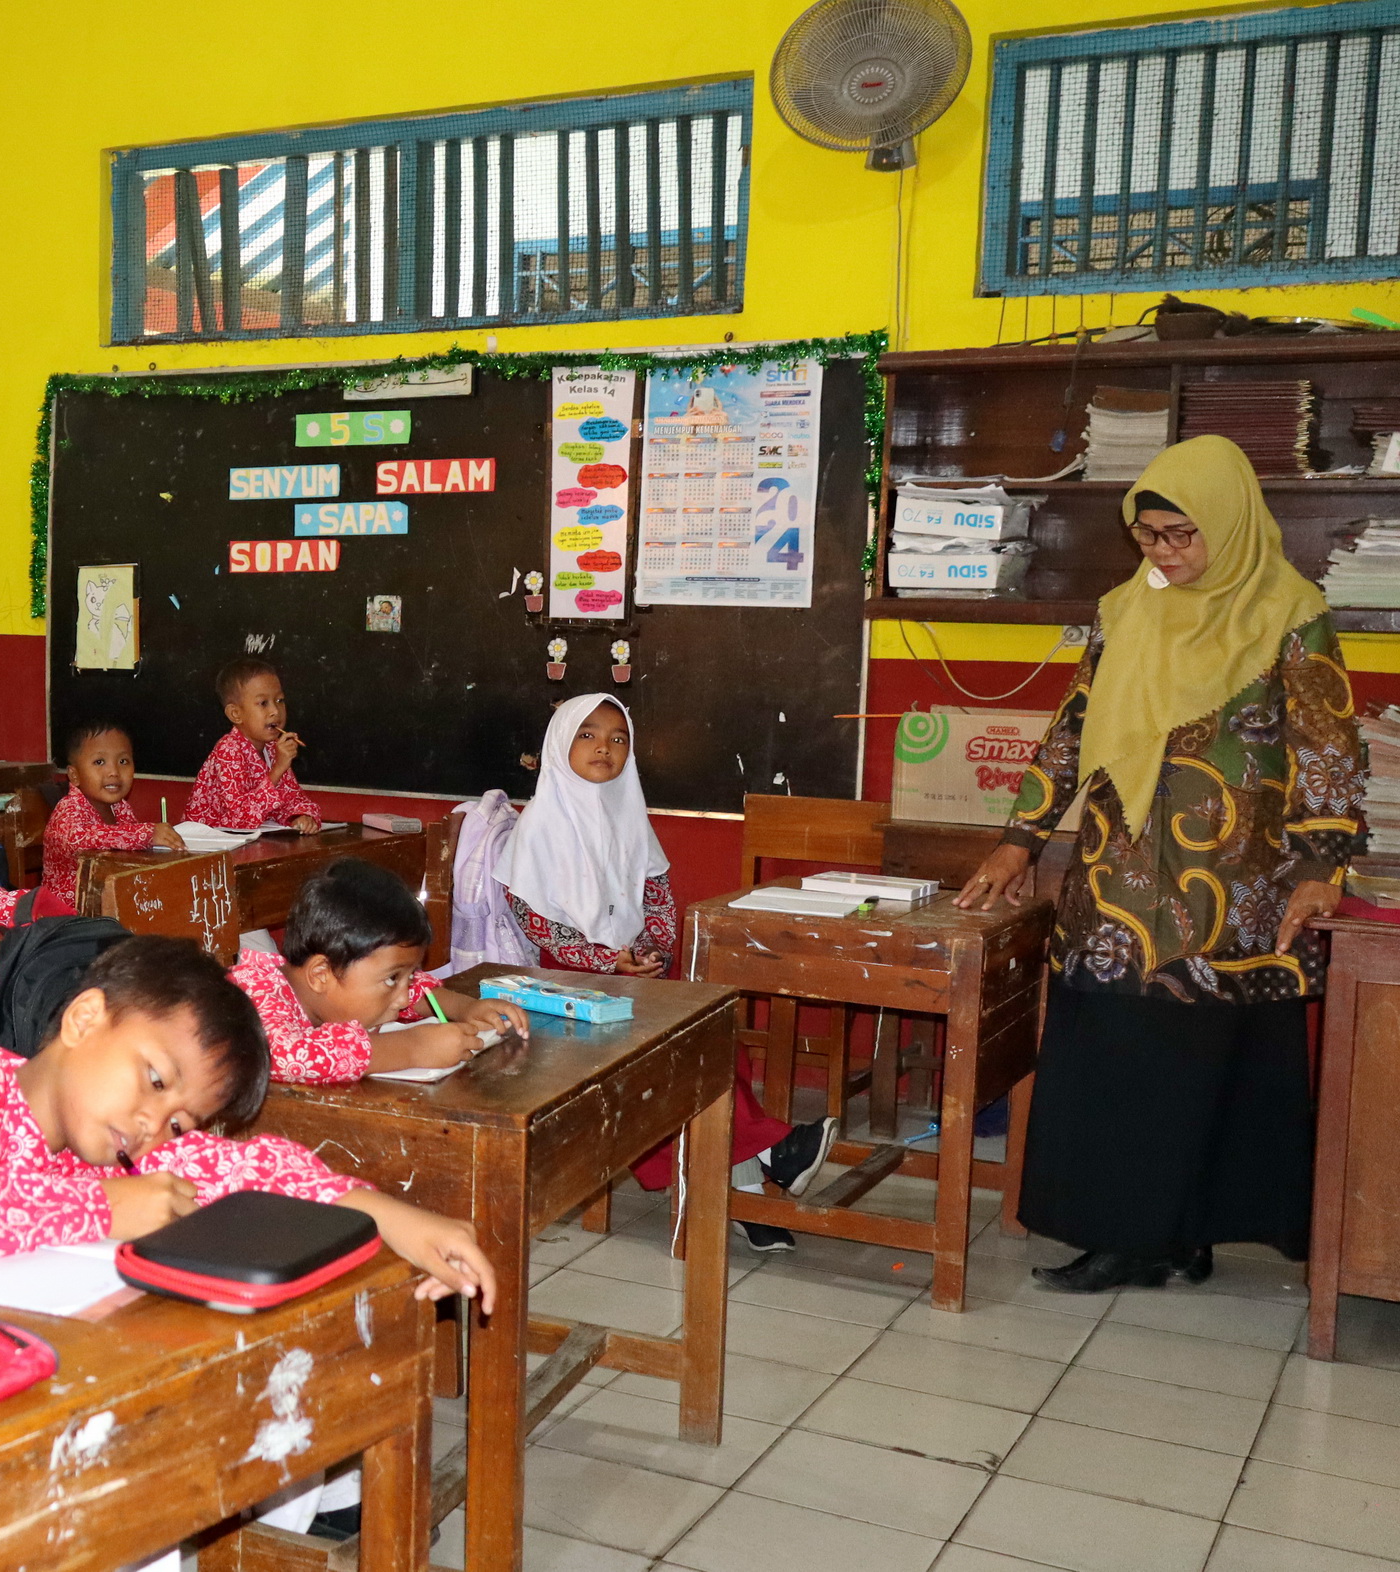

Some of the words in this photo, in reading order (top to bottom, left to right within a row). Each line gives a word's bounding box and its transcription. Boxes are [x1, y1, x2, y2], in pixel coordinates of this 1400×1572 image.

[569, 386, 599, 394] Kelas
[603, 386, 616, 397] 1A
[329, 412, 350, 446] 5
[362, 413, 385, 443] S
[654, 425, 694, 435] MENJEMPUT
[696, 424, 742, 434] KEMENANGAN
[230, 466, 339, 498] SENYUM
[376, 460, 491, 494] SALAM
[318, 503, 392, 534] SAPA
[902, 507, 922, 523] 70
[926, 515, 942, 524] F4
[953, 512, 995, 528] SiDU
[230, 540, 338, 571] SOPAN
[897, 564, 916, 578] 70
[919, 570, 935, 578] F4
[948, 564, 988, 578] SiDU
